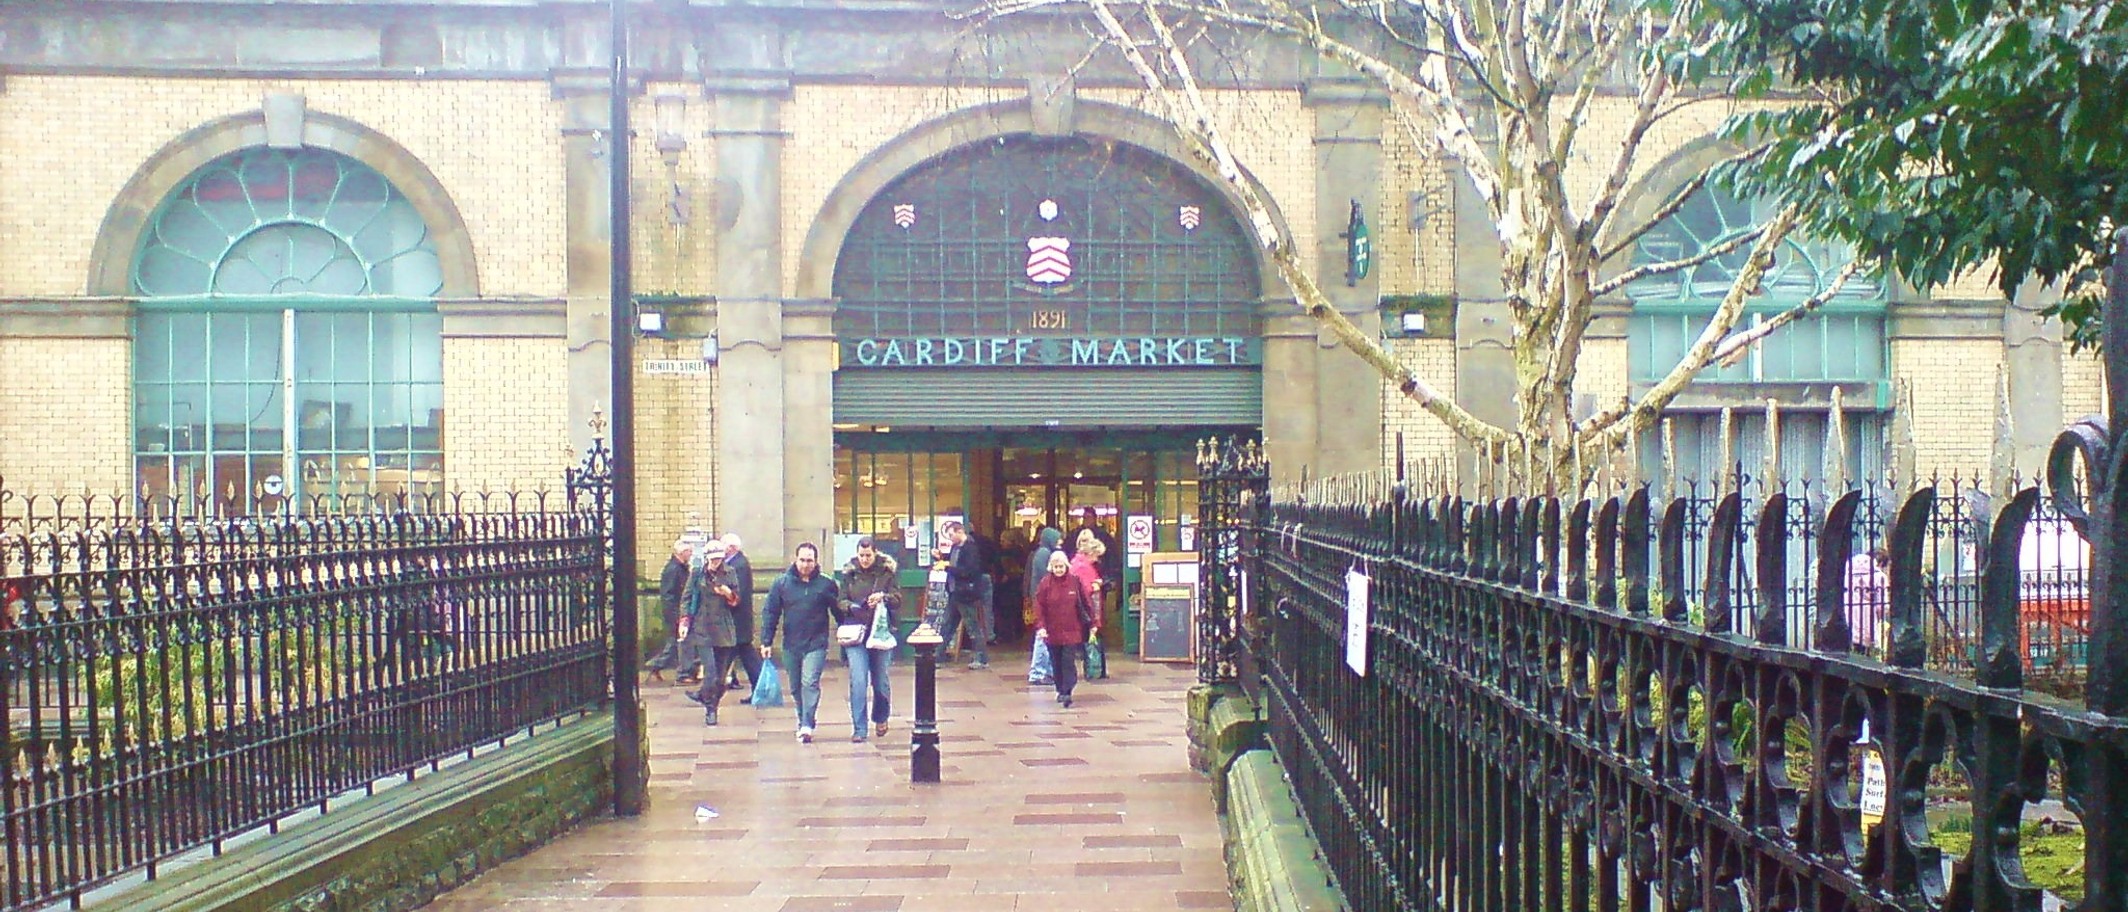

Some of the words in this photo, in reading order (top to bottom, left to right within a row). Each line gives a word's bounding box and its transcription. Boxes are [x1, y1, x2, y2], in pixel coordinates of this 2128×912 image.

[1031, 310, 1066, 330] 1891
[856, 337, 1034, 366] CARDIFF
[1070, 337, 1244, 366] MARKET
[679, 361, 707, 371] STREET
